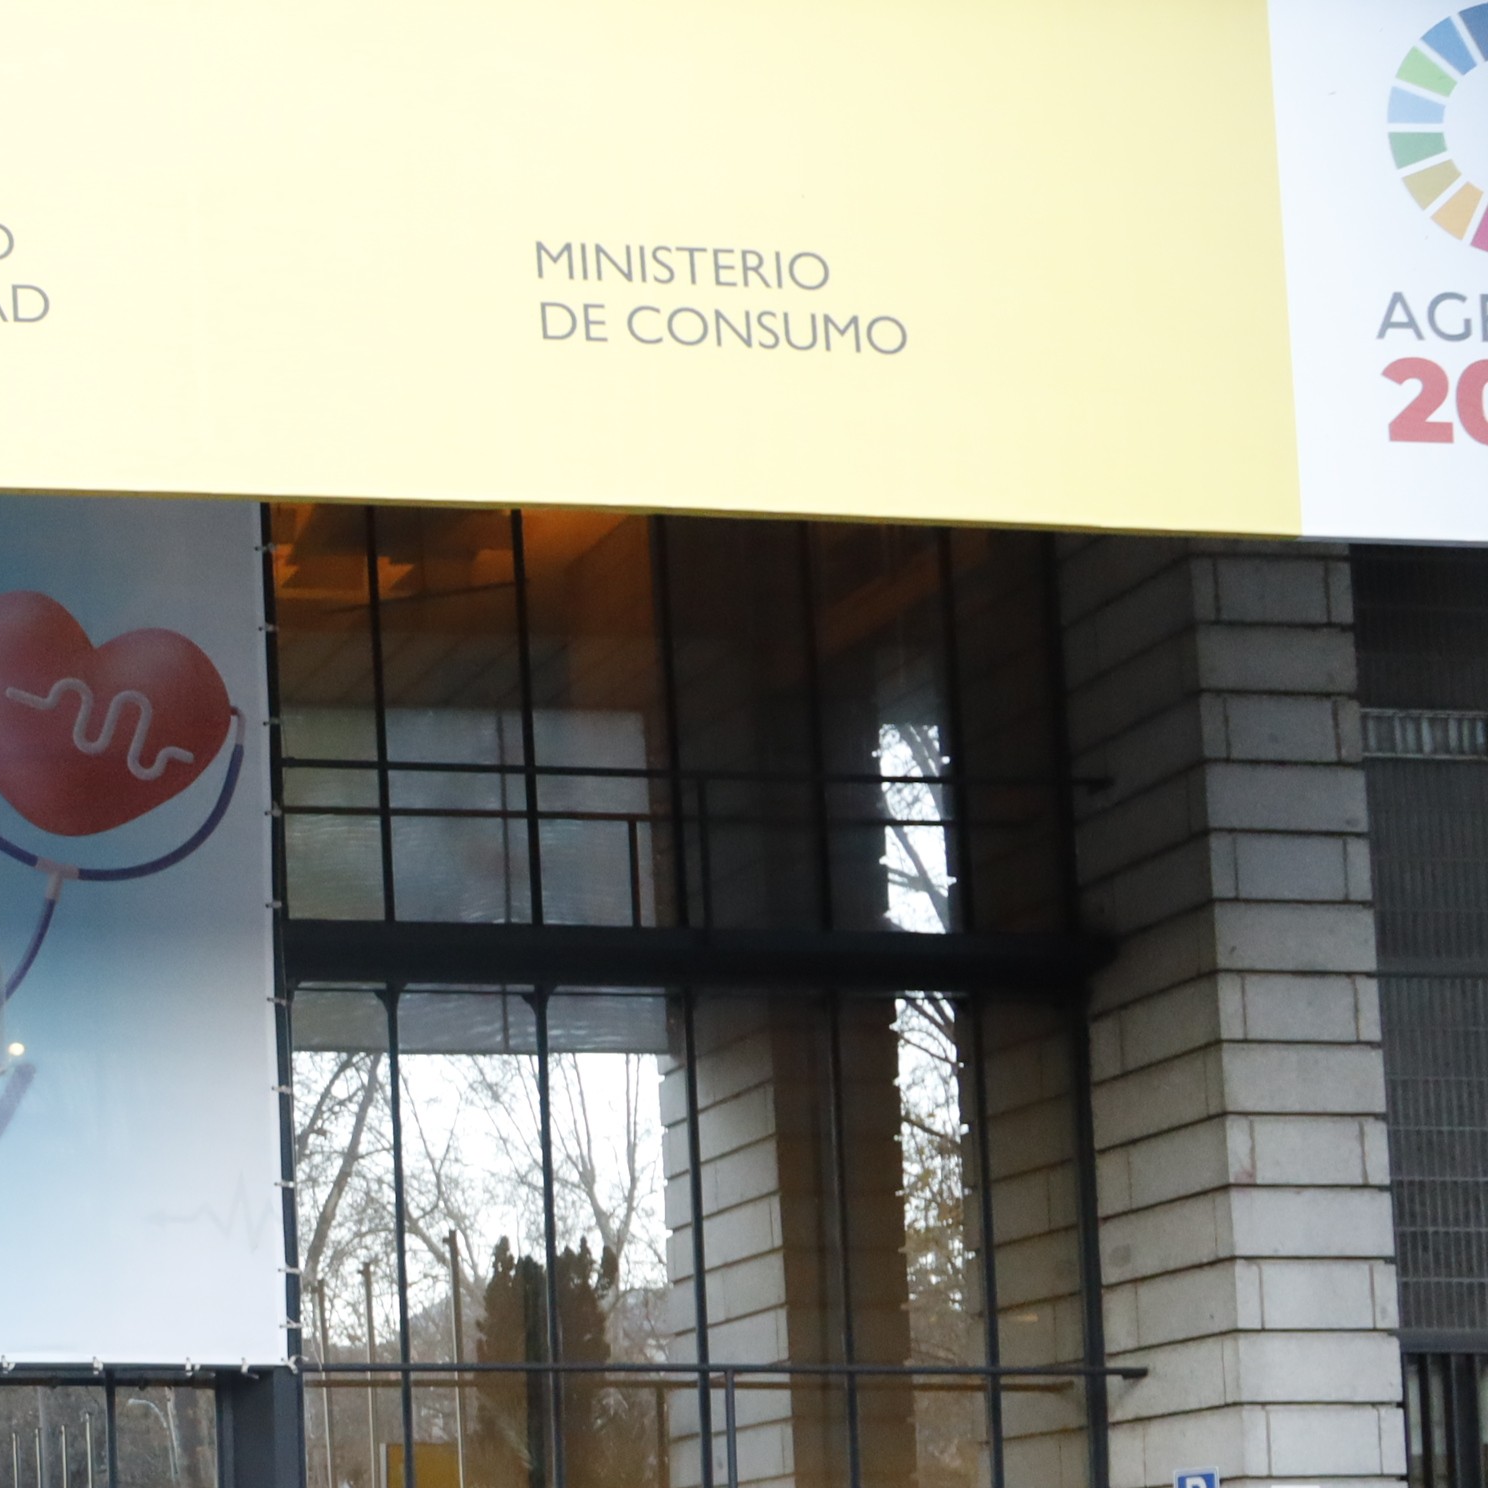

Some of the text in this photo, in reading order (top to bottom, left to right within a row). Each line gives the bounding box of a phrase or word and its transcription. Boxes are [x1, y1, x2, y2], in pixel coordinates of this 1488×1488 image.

[535, 240, 830, 291] MINISTERIO
[540, 301, 907, 355] DE CONSUMO
[1376, 290, 1488, 343] AG
